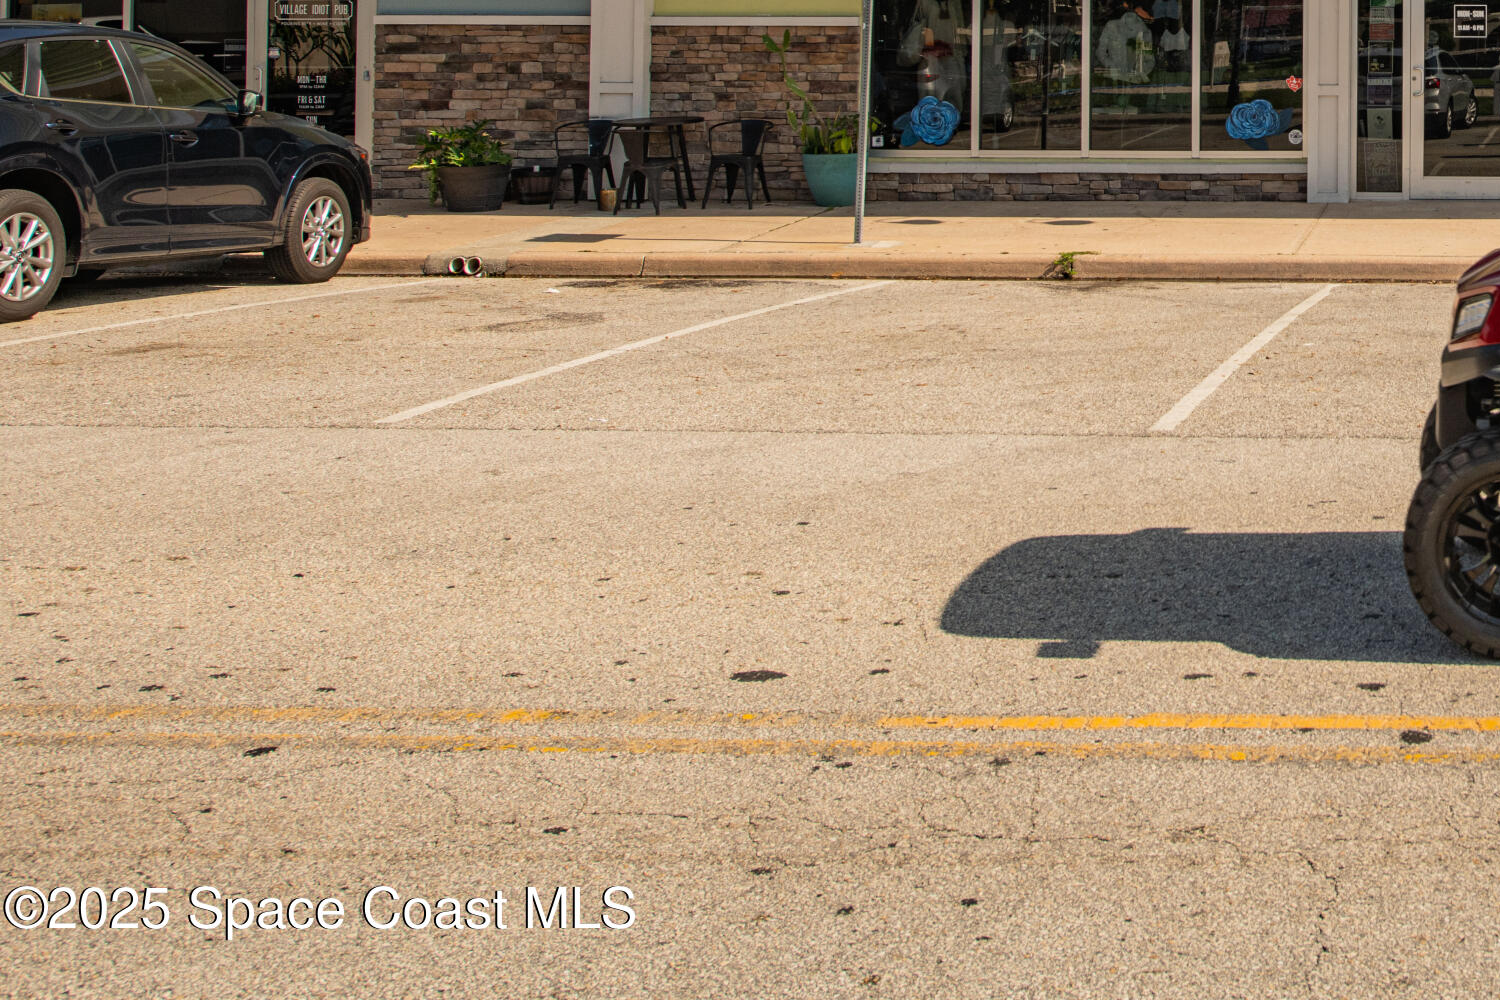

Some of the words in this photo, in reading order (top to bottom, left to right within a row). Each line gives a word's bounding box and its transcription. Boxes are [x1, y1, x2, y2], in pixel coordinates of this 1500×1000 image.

[280, 4, 307, 14] VILLAGE
[312, 4, 330, 14] IDIOT
[335, 4, 348, 14] PUB
[297, 96, 307, 104] FRI
[314, 96, 326, 104] SAT
